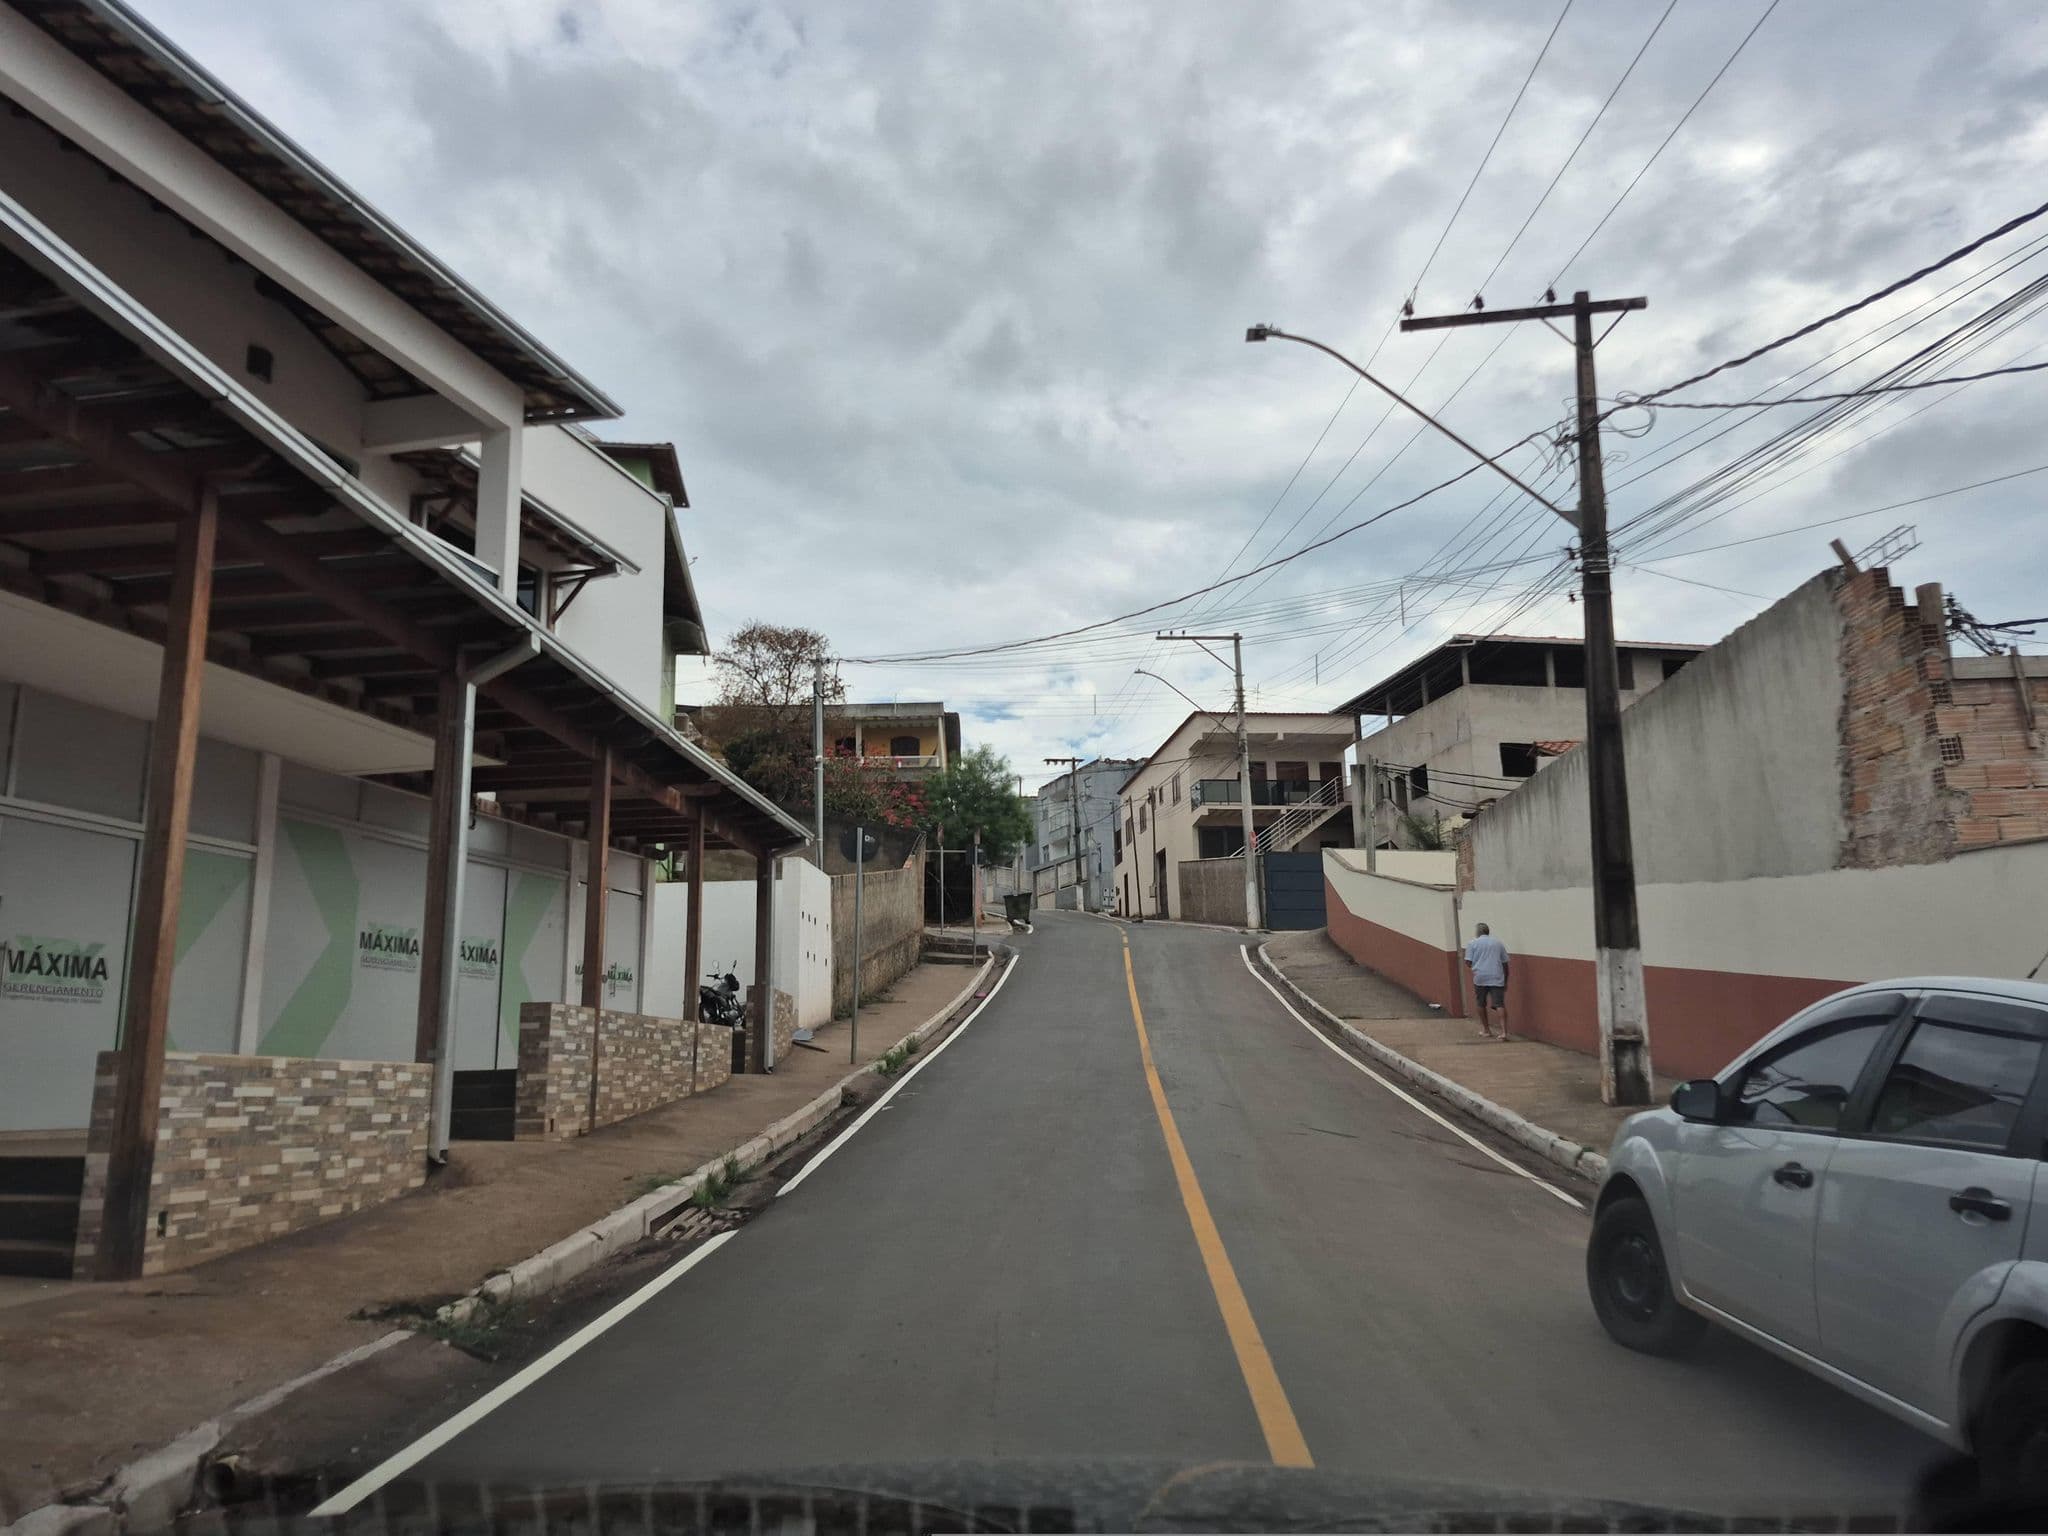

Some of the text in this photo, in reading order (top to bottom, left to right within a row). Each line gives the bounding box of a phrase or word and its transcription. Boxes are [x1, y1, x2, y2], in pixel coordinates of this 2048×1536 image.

[359, 929, 420, 956] MÁXIMA
[460, 940, 498, 965] ÁXIMA
[6, 945, 108, 980] MÁXIMA
